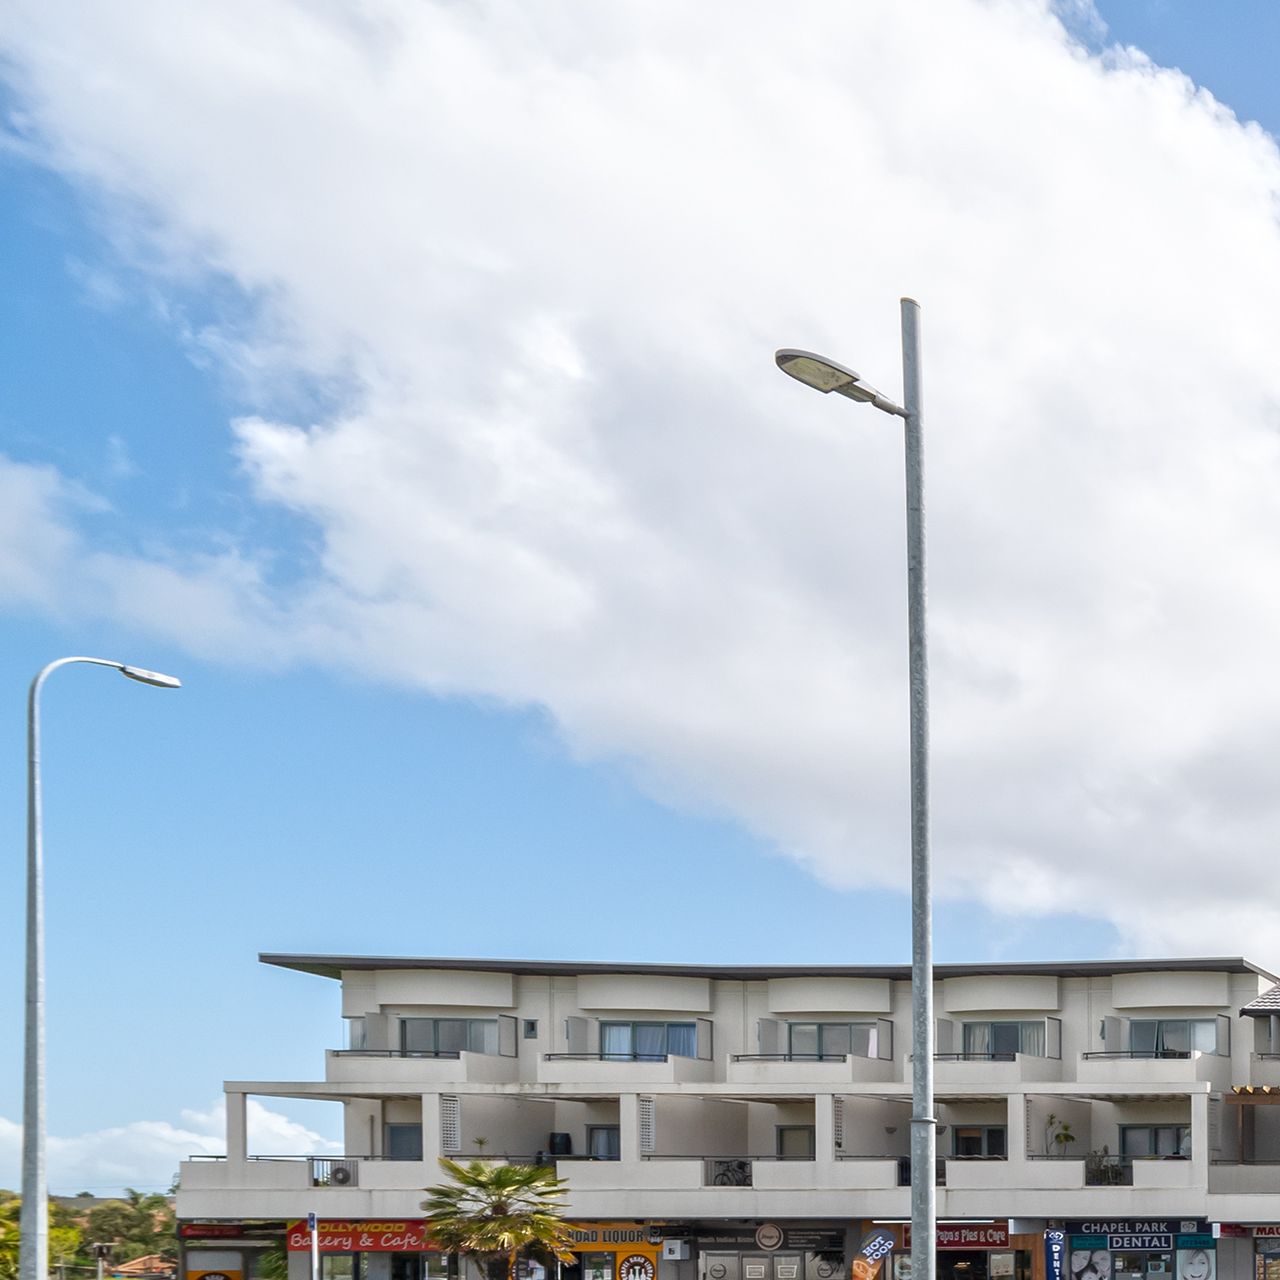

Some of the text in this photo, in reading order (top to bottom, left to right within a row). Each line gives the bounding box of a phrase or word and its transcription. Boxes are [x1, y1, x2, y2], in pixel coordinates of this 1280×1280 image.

[305, 1223, 406, 1232] OLLYWOOD
[1081, 1222, 1168, 1233] CHAPEL PARK
[359, 1233, 373, 1246] &
[380, 1233, 419, 1249] Cafe
[603, 1230, 643, 1243] LIQUOR
[961, 1229, 977, 1242] Pies
[979, 1231, 985, 1242] &
[987, 1229, 1006, 1243] Cafe
[1112, 1237, 1168, 1248] DENTAL
[862, 1236, 885, 1256] HOT
[866, 1241, 894, 1265] FOOD
